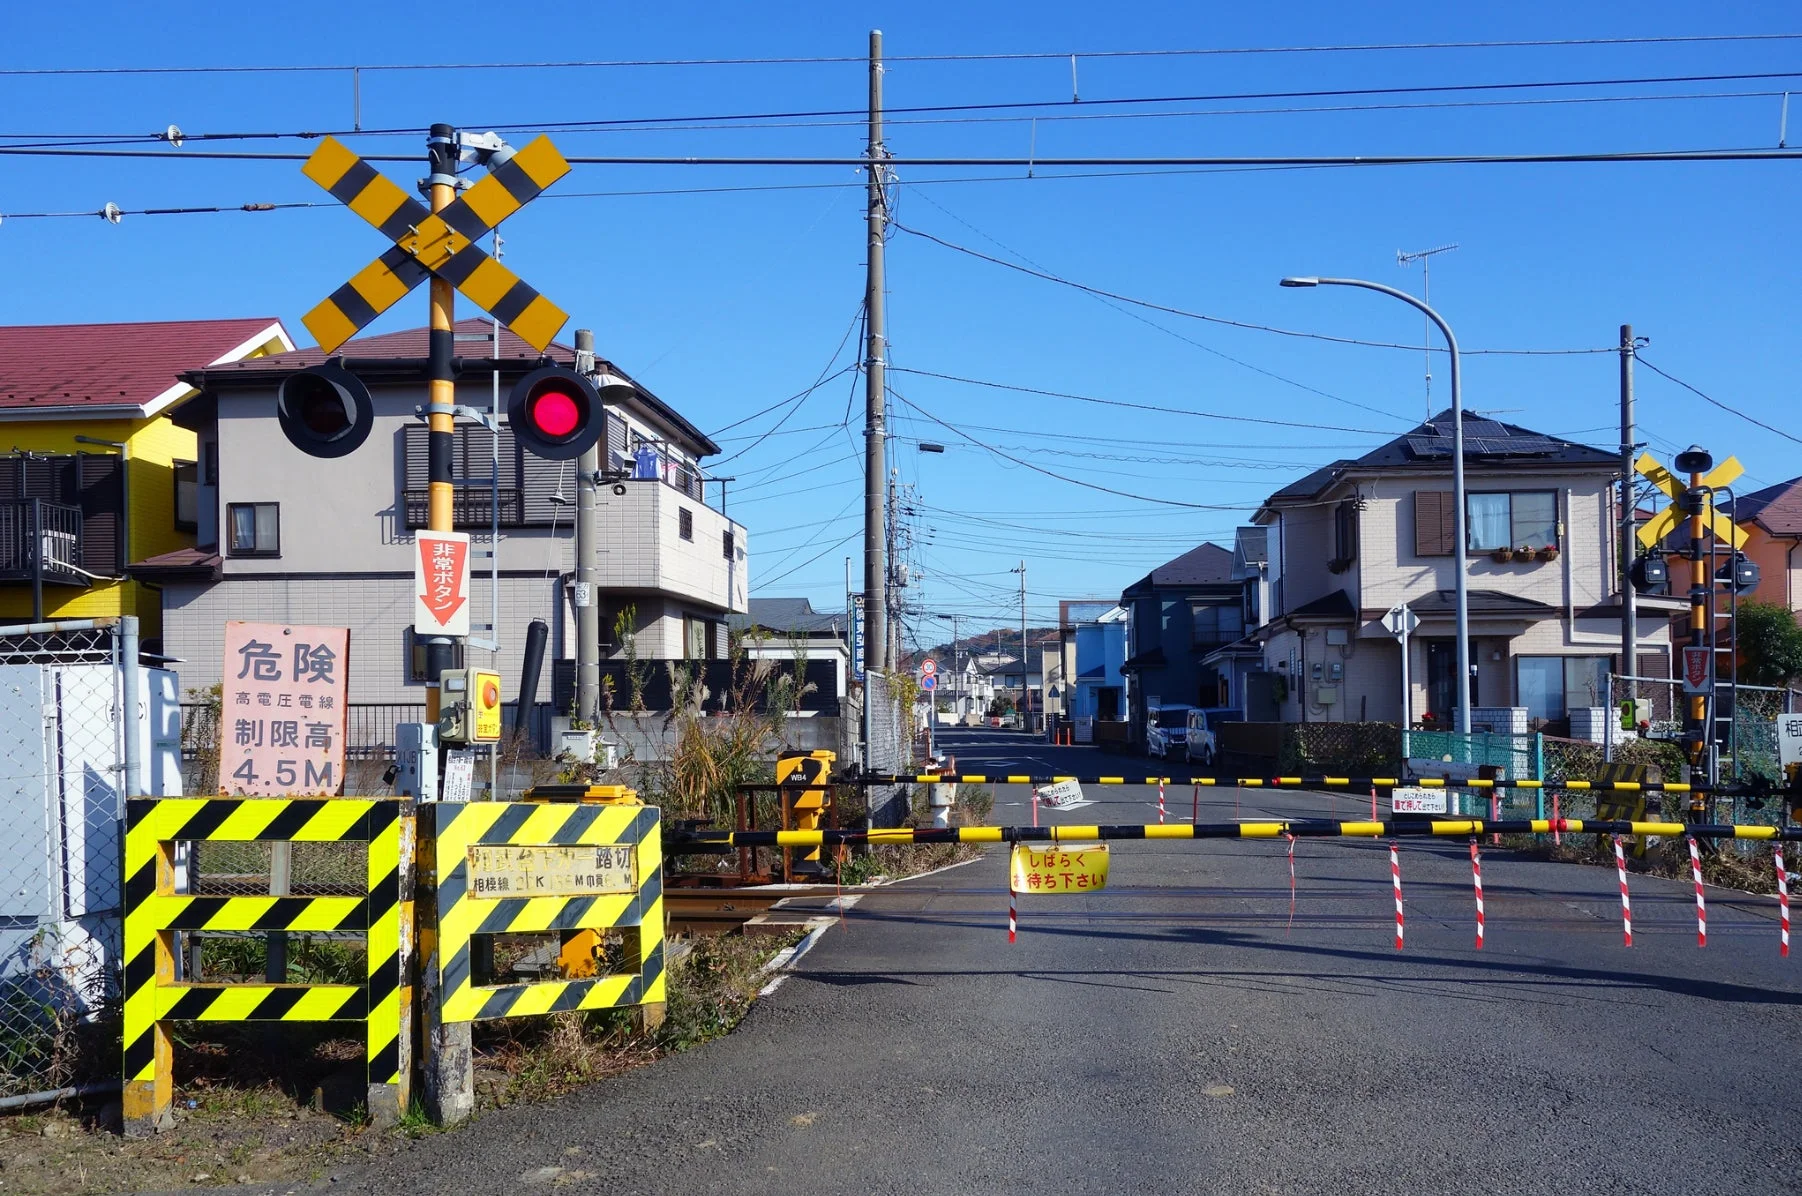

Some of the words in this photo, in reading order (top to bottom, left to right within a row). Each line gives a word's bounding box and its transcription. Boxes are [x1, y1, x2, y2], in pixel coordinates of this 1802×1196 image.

[432, 543, 455, 610] 非常ボタン
[576, 590, 586, 599] 63
[237, 639, 336, 684] 危険
[235, 691, 334, 709] 高電圧電線
[235, 718, 333, 749] 制限高
[233, 758, 332, 787] 4.5M
[1030, 854, 1085, 868] しばらく
[1013, 873, 1105, 889] お待ち下さい
